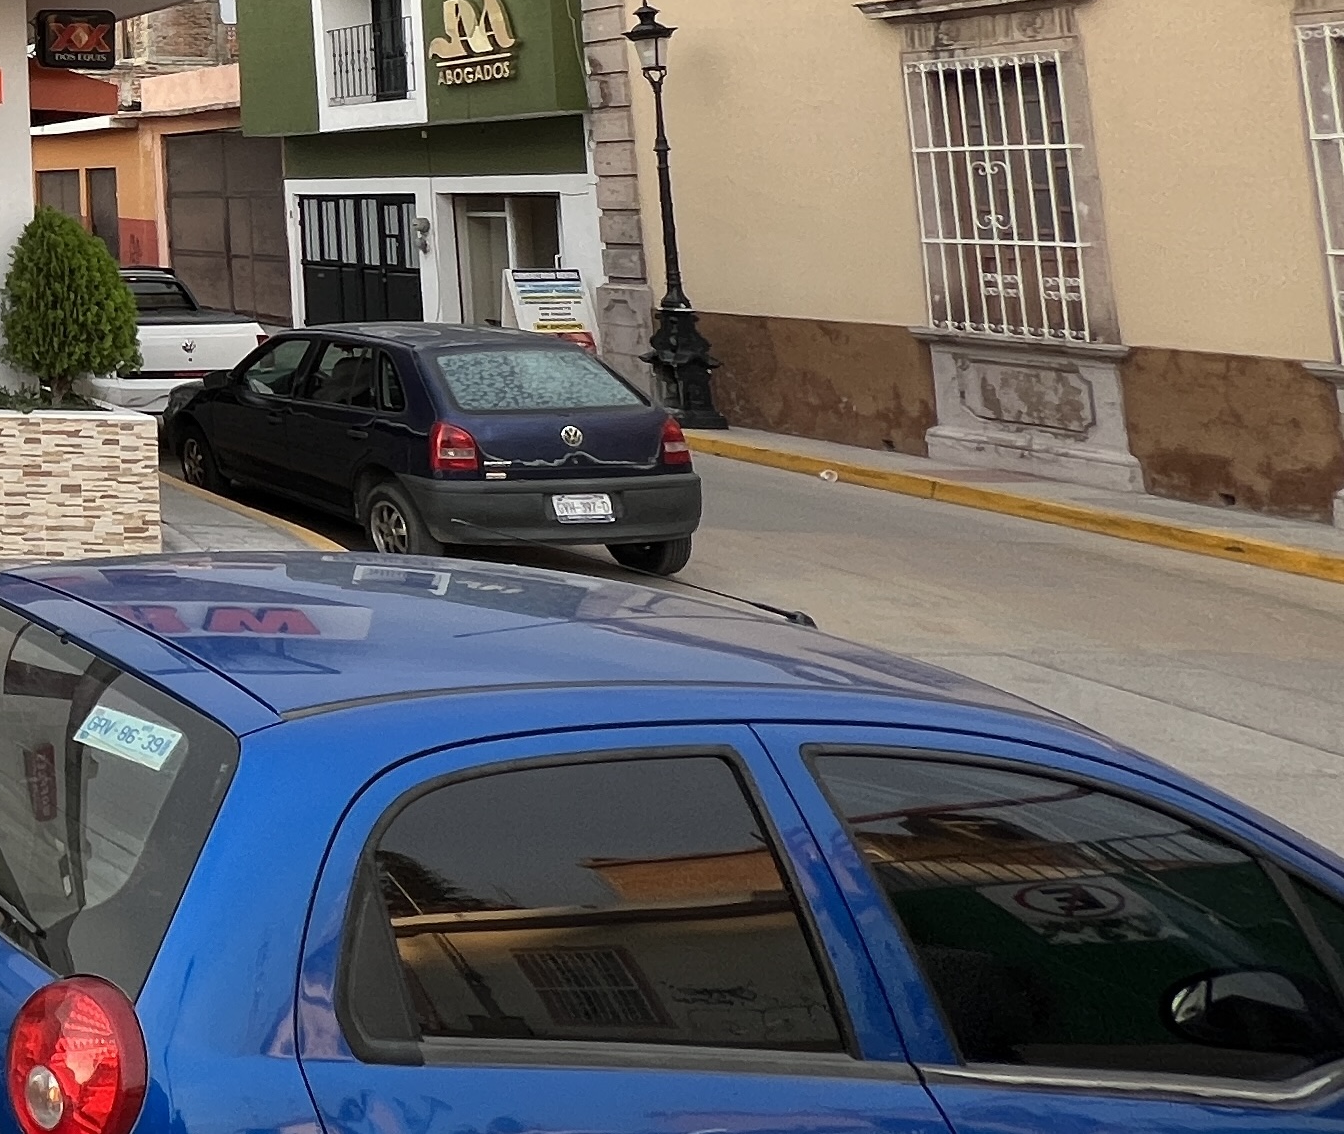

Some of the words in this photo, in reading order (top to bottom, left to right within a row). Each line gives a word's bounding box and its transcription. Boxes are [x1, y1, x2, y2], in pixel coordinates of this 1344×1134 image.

[55, 53, 75, 61] DOS
[77, 53, 107, 62] EQUIS
[437, 61, 510, 85] ABOGADOS
